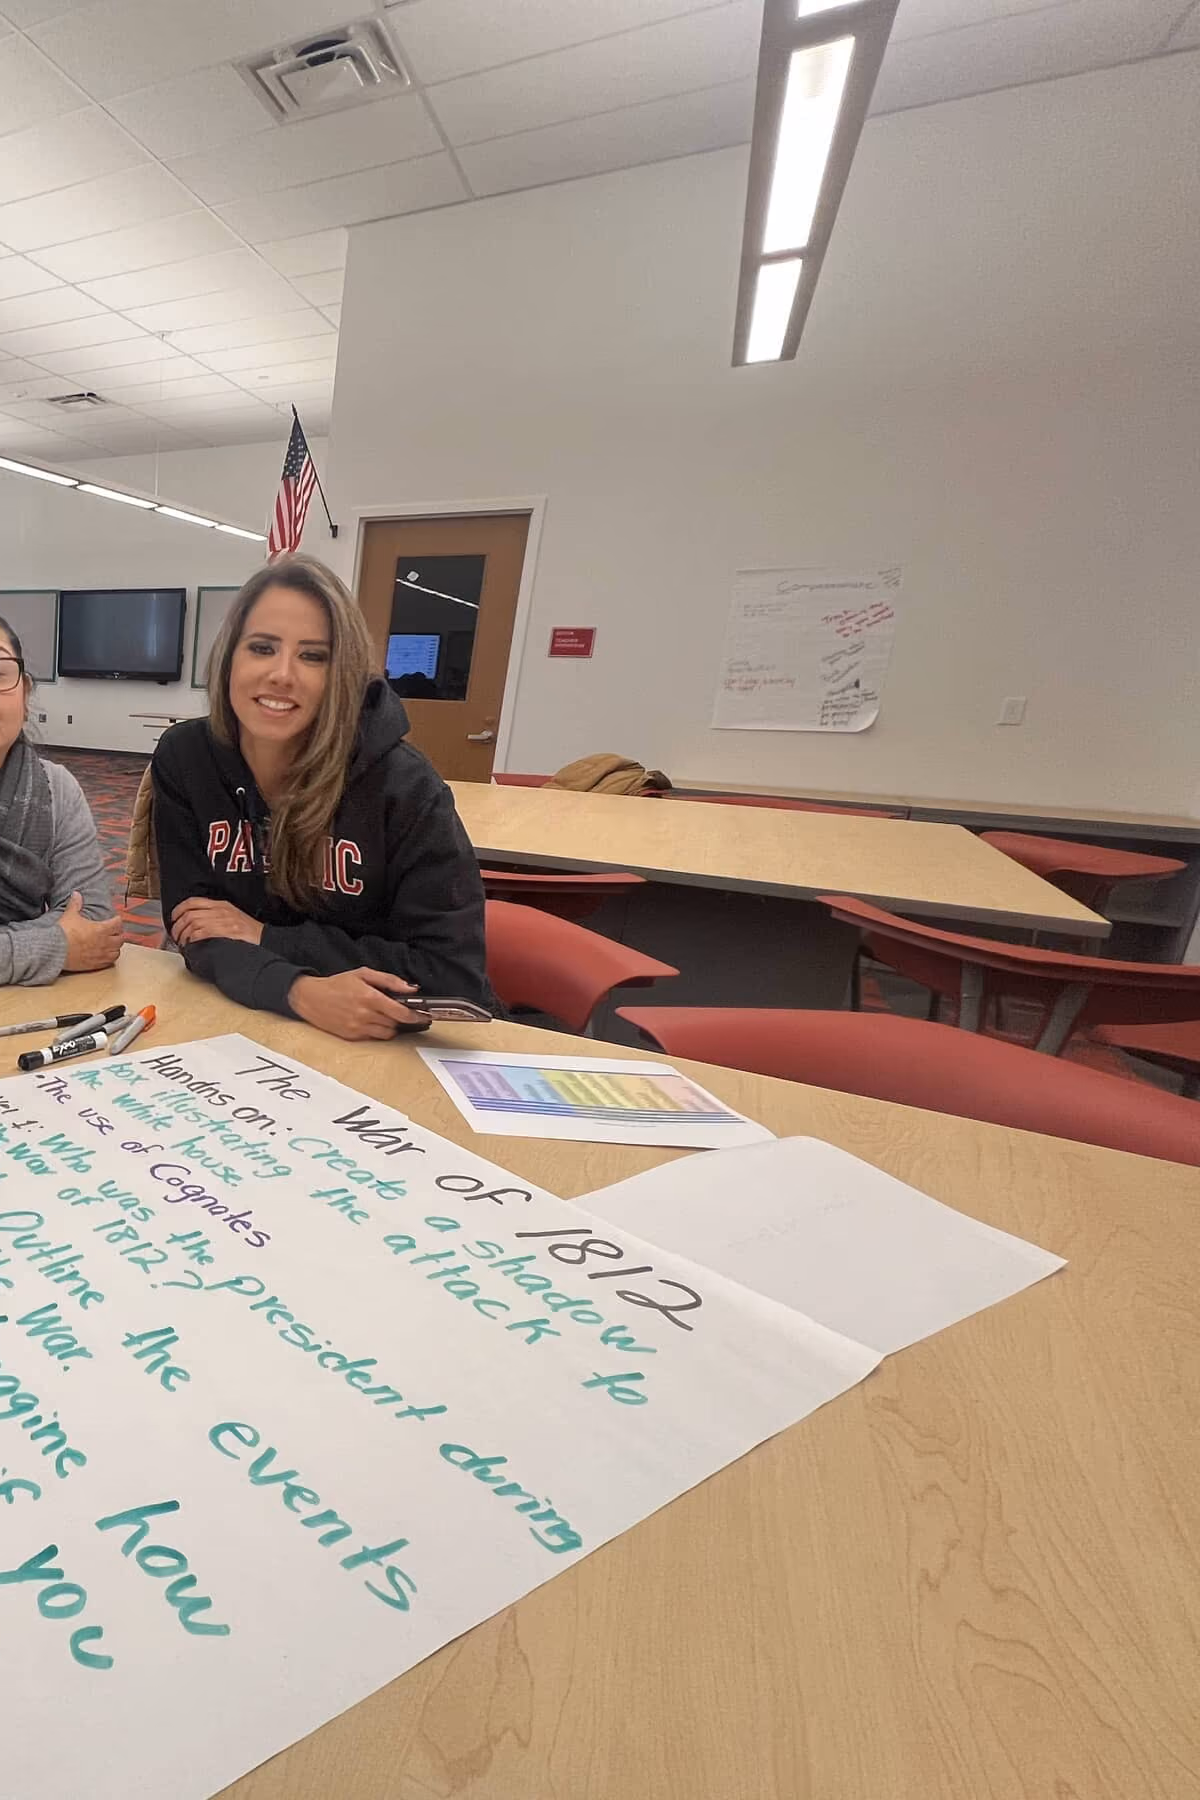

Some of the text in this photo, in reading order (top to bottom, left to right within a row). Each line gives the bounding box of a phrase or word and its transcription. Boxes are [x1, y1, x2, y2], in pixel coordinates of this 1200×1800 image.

[207, 818, 363, 895] PAIC
[37, 1076, 271, 1248] The use of Cognates
[69, 1069, 103, 1090] the
[57, 1187, 104, 1206] of
[102, 1063, 649, 1405] box illustrating the attack to
[231, 1107, 293, 1135] on:
[424, 1216, 461, 1232] a
[461, 1240, 657, 1353] shadow
[235, 1056, 702, 1331] The War of 1812
[11, 1120, 44, 1133] 1:
[38, 1133, 96, 1173] Who
[97, 1180, 156, 1222] was
[165, 1230, 215, 1265] the
[439, 1443, 583, 1554] during
[94, 1500, 231, 1637] how
[121, 1327, 191, 1392] the
[208, 1421, 418, 1612] events
